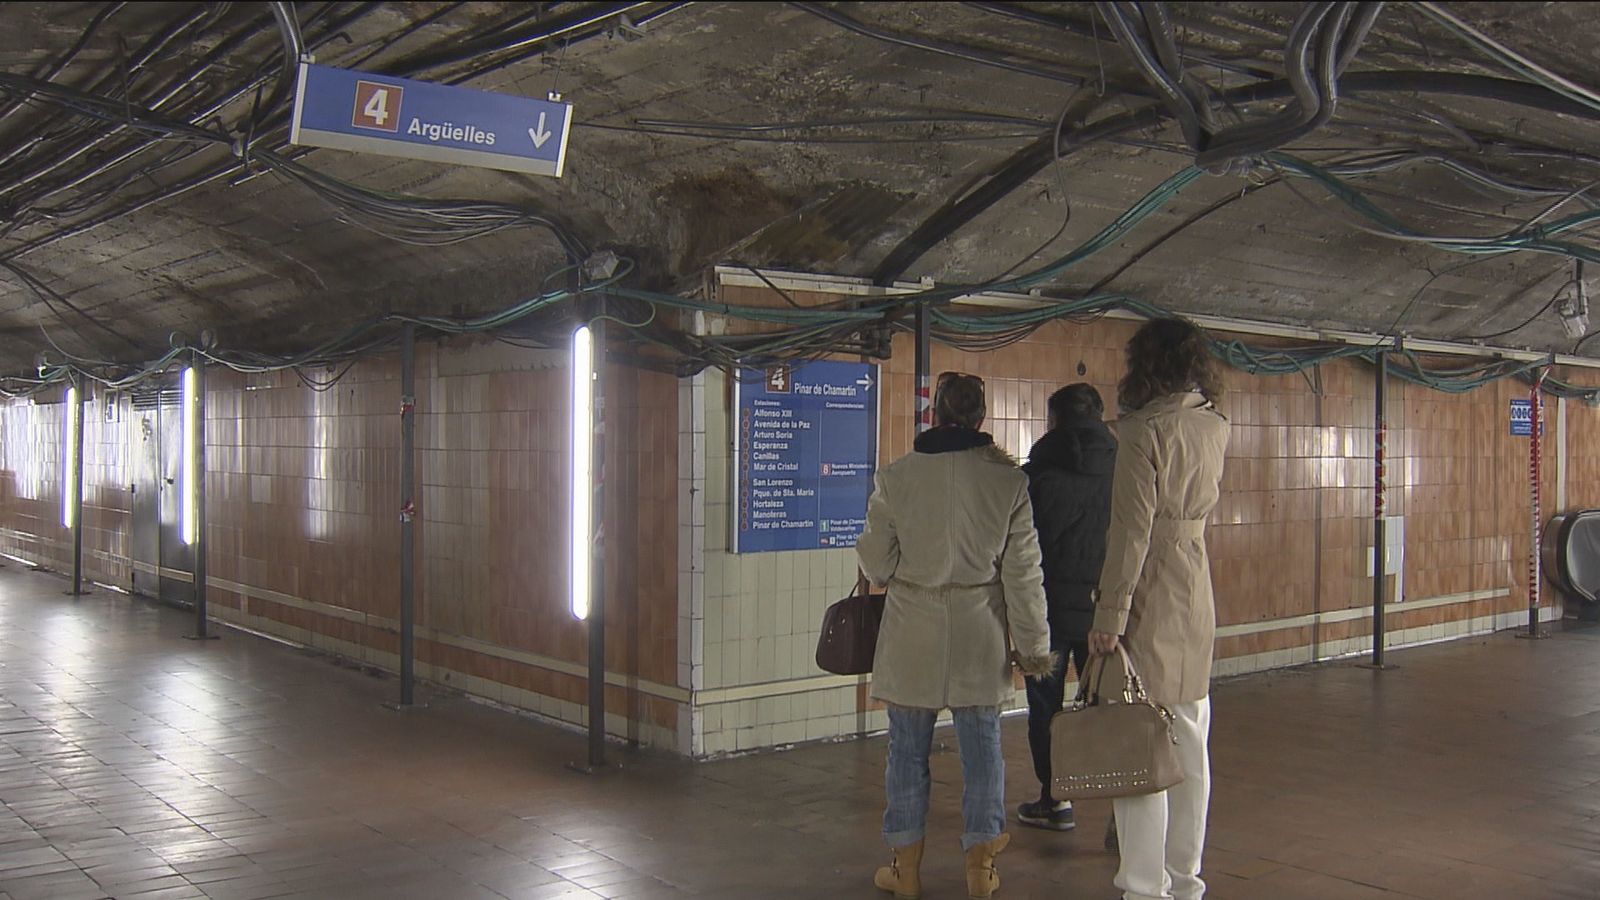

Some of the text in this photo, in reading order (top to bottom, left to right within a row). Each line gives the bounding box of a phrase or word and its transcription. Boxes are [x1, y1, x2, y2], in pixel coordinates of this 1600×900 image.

[364, 89, 496, 145] 4 Argüelles
[771, 367, 785, 391] 4
[794, 382, 812, 395] Pinar
[813, 383, 822, 395] de
[754, 409, 780, 418] Alfonso
[754, 420, 780, 429] Avenida
[799, 421, 810, 429] Paz
[754, 431, 793, 439] Arturo Soria
[753, 441, 788, 450] Esperanza
[753, 452, 780, 460] Canillas
[754, 462, 767, 471] Mar
[777, 462, 799, 470] Cristal
[753, 489, 772, 499] Pque.
[773, 489, 782, 497] de
[783, 488, 796, 497] Sta.
[753, 500, 784, 509] Hortaleza
[753, 520, 771, 530] Pinar
[771, 521, 780, 529] de
